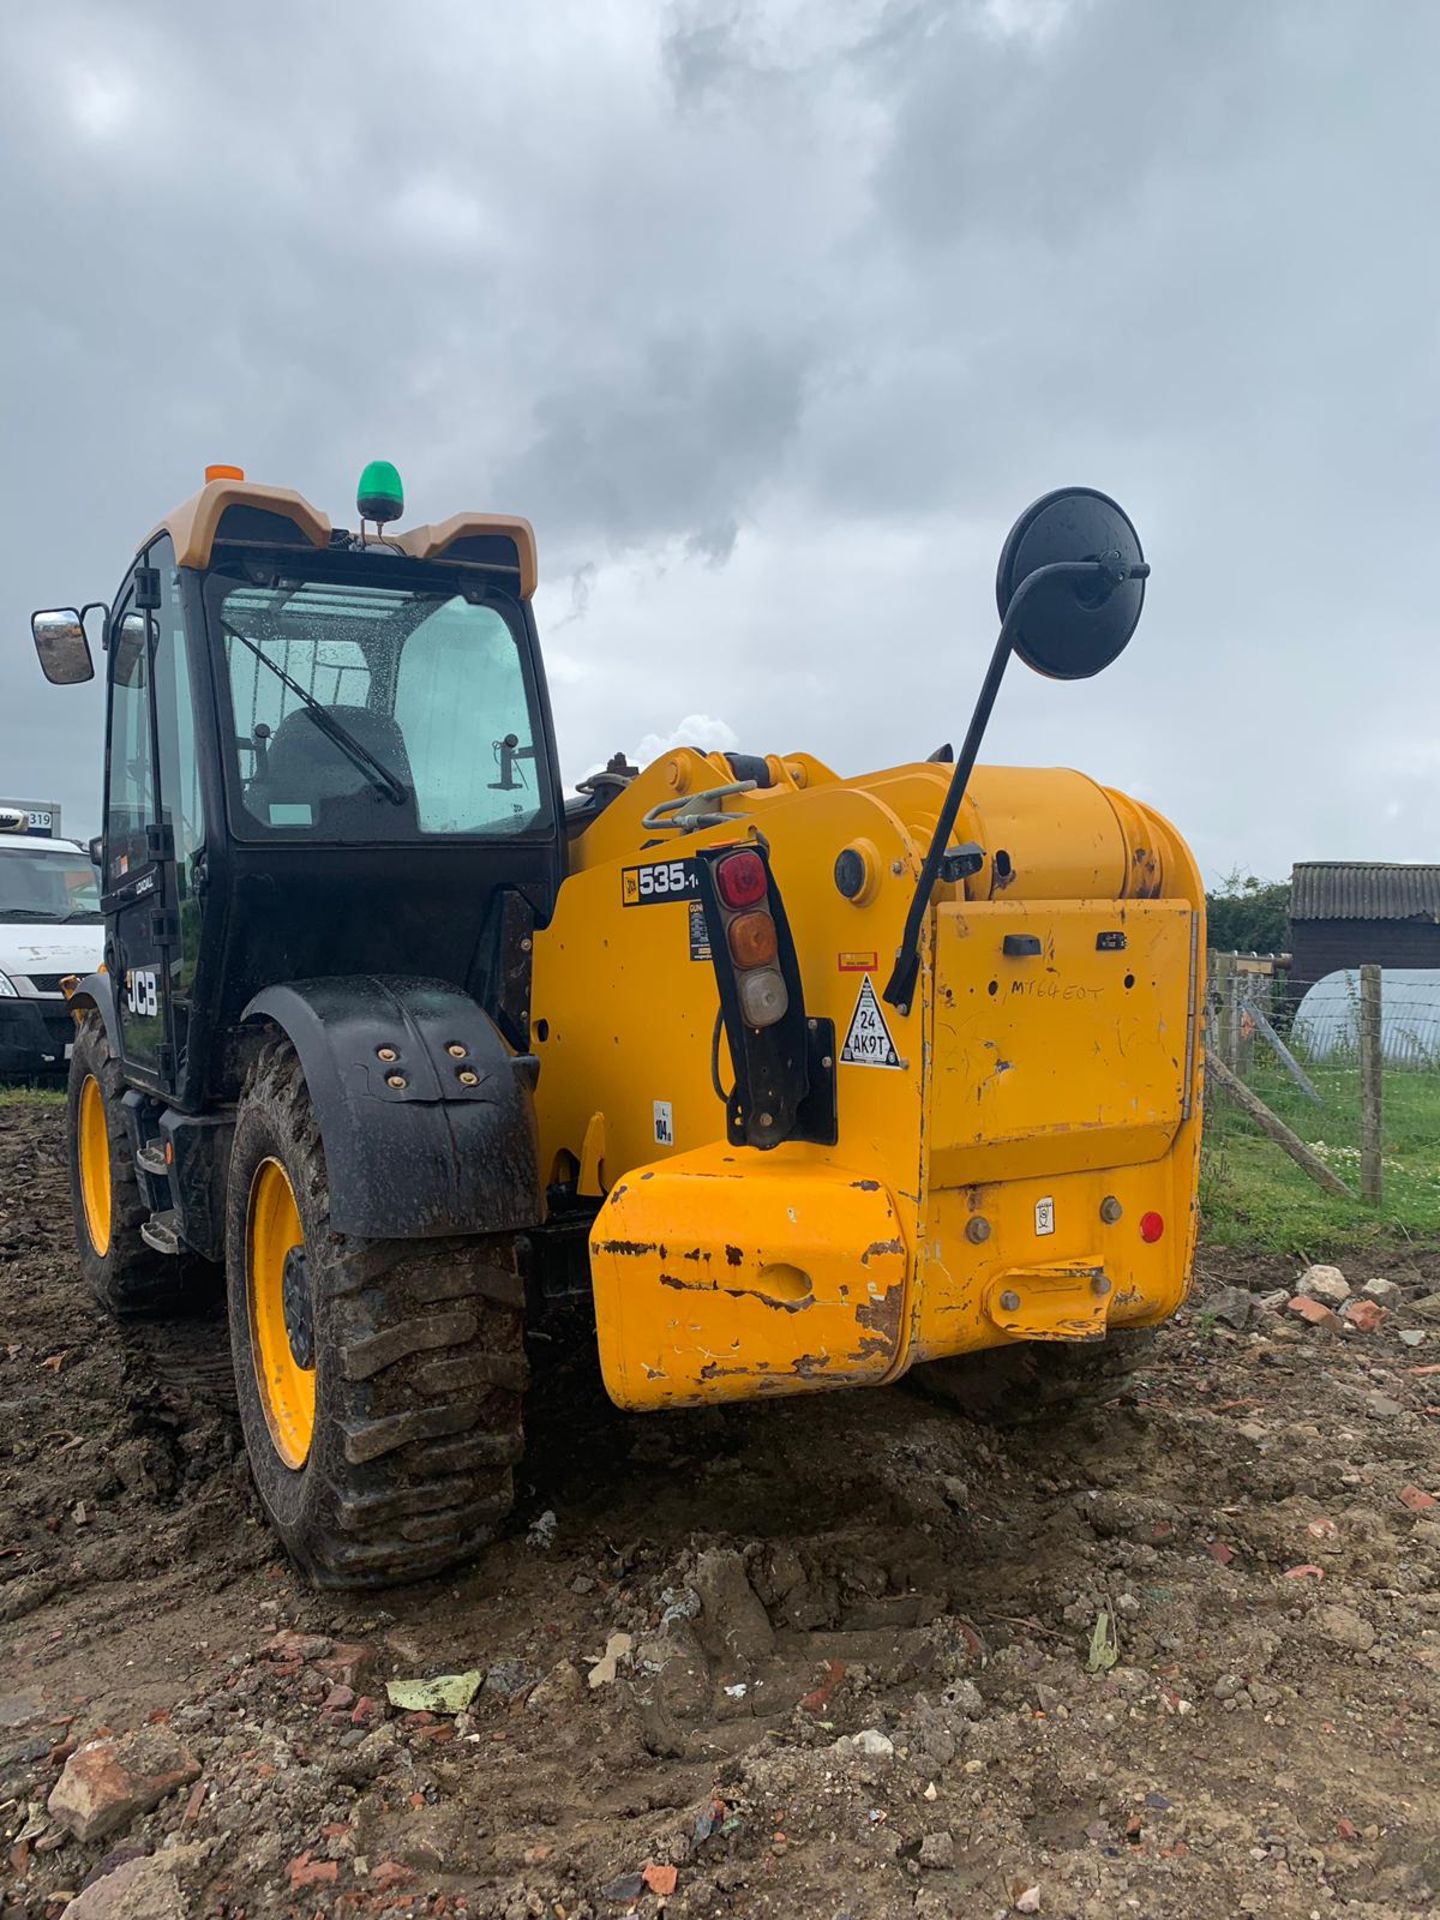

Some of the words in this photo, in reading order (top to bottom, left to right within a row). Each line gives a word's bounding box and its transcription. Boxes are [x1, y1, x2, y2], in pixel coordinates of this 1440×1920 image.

[30, 813, 50, 825] 319
[127, 970, 157, 1017] JCB
[860, 1011, 875, 1029] 24
[853, 1035, 885, 1054] AK9T
